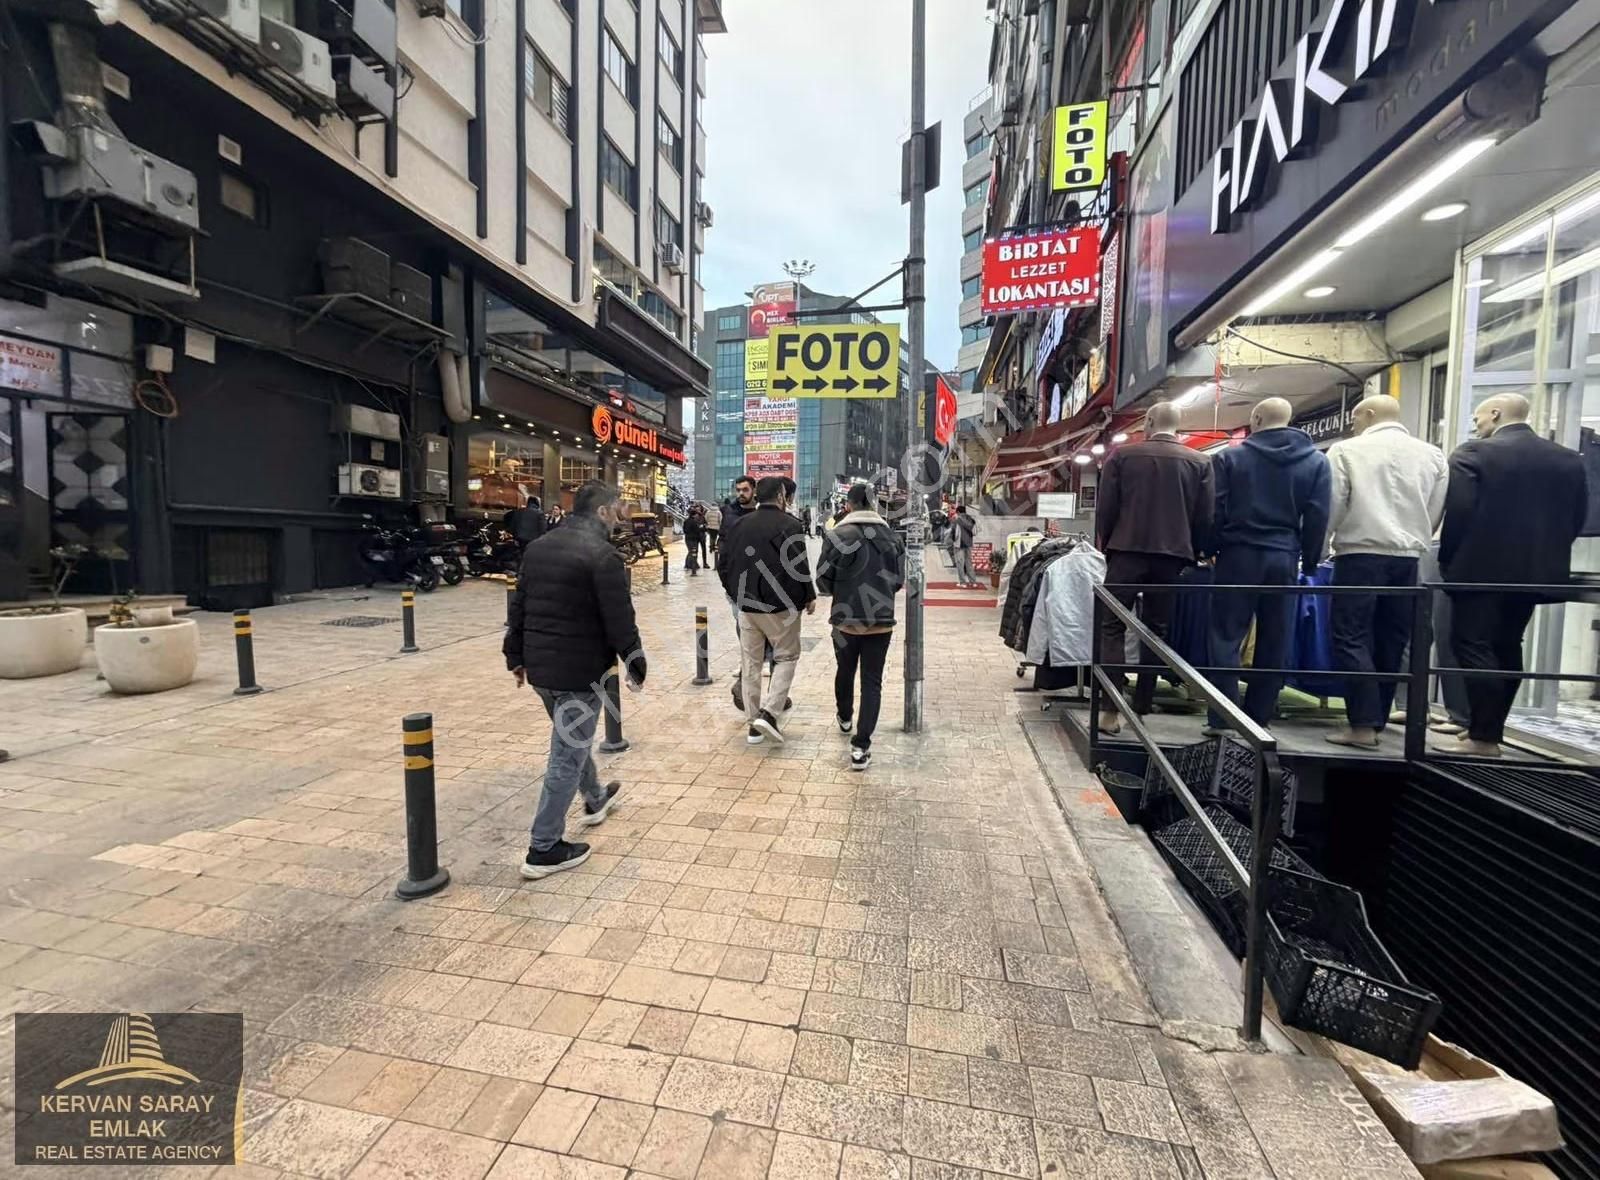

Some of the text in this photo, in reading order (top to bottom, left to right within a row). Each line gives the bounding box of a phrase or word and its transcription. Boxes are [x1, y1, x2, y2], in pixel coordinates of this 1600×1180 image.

[1065, 107, 1095, 185] FOTO
[1011, 263, 1067, 278] LEZZET
[989, 277, 1089, 304] LOKANTASI
[776, 331, 891, 371] FOTO
[615, 419, 658, 453] güneli
[1301, 414, 1341, 437] SELÇUK
